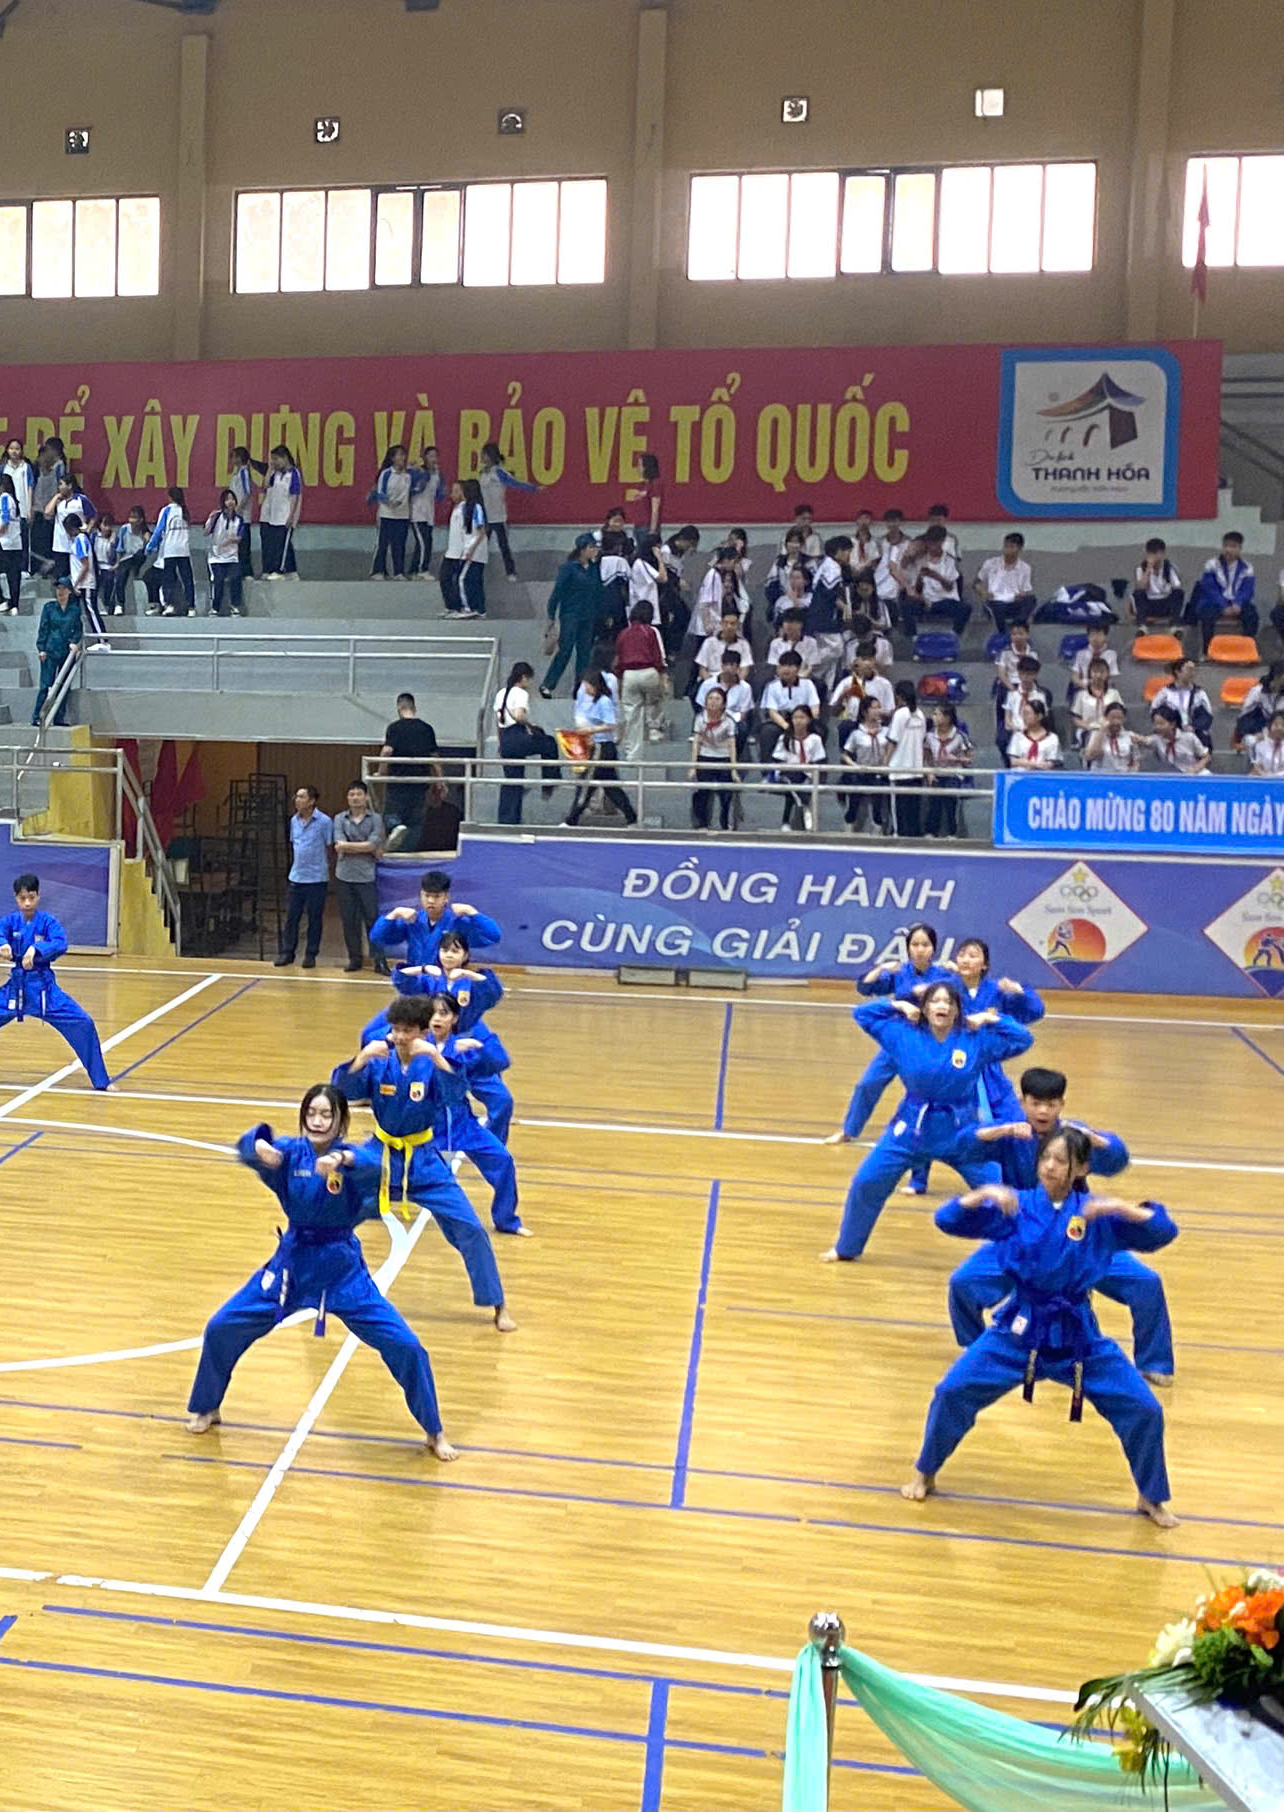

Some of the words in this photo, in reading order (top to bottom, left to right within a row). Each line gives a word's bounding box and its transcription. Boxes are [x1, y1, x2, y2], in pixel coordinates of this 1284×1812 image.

[101, 399, 200, 489] XÂY
[216, 404, 356, 500] DỰNG
[374, 393, 437, 474] VÀ
[458, 381, 566, 486] BẢO
[585, 388, 651, 502] VỆ
[669, 372, 742, 484] TỔ
[756, 372, 911, 493] QUỐC
[1031, 467, 1101, 481] THANH
[1107, 461, 1150, 481] HÓA
[1085, 792, 1146, 832] MỪNG
[1150, 799, 1175, 832] 80
[1179, 793, 1227, 834] NĂM
[1231, 794, 1284, 836] NGÀY
[622, 856, 780, 904] ĐỒNG
[796, 867, 956, 911] HÀNH
[542, 913, 693, 956] CÙNG
[712, 918, 822, 962] GIẢI
